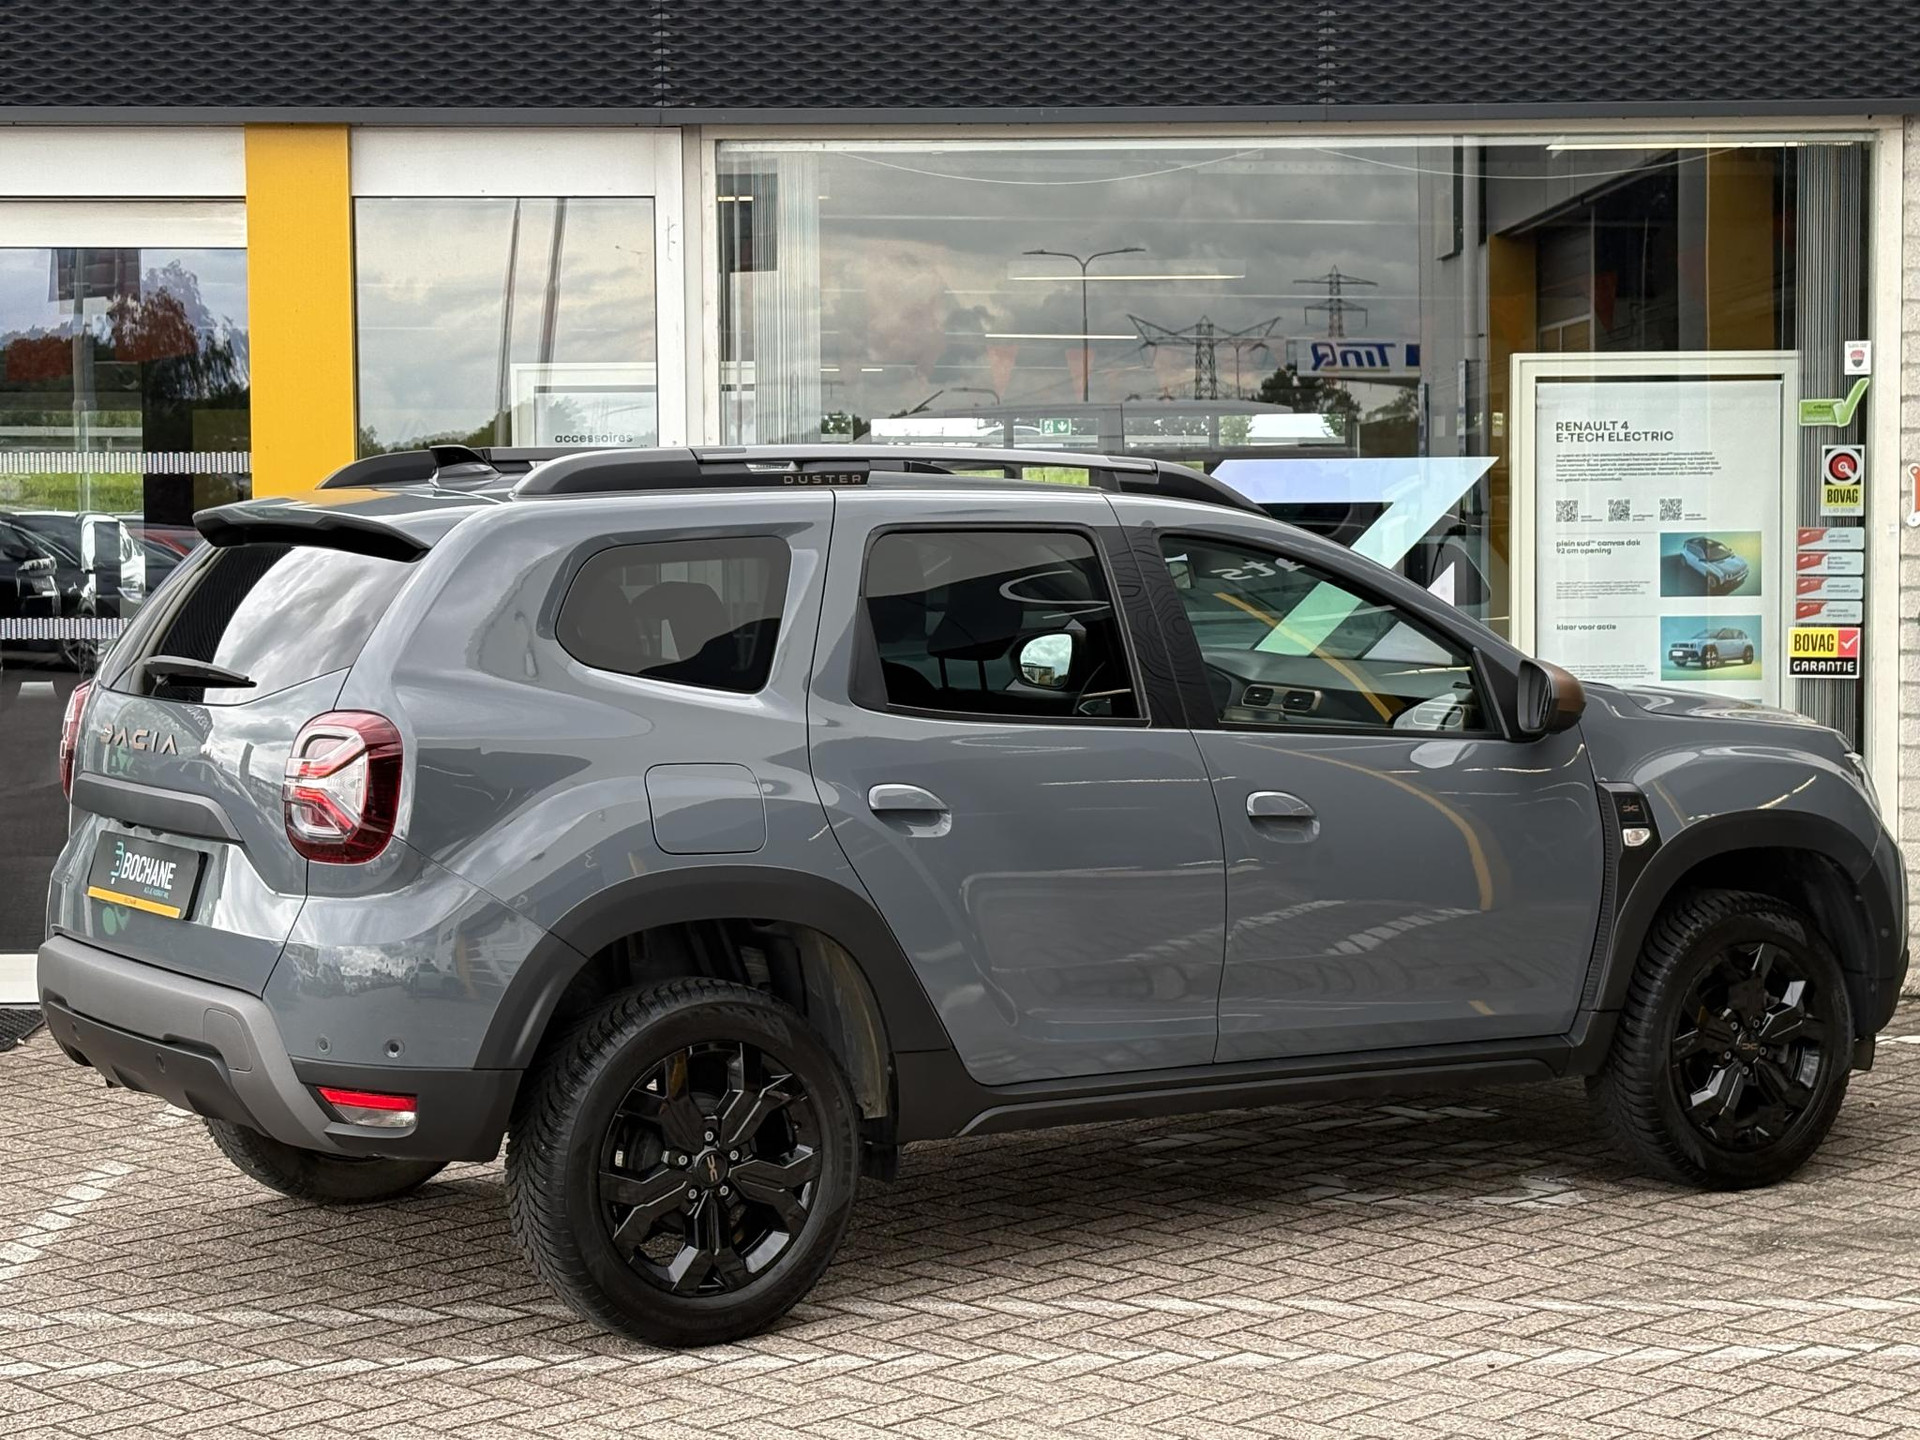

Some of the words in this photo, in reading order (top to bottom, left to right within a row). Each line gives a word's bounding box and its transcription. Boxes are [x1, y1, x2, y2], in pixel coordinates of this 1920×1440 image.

[1556, 421, 1618, 432] RENAULT
[1621, 421, 1630, 431] 4
[554, 432, 634, 443] accessoires
[1556, 432, 1605, 443] E-TECH
[1608, 431, 1674, 442] ELECTRIC
[783, 475, 862, 485] DUSTER
[1826, 488, 1859, 504] BOVAG
[1580, 547, 1612, 555] opening
[1794, 633, 1835, 652] BOVAG
[1792, 660, 1855, 673] GARANTIE
[99, 723, 179, 756] DACIA
[120, 852, 177, 890] BOCHANE
